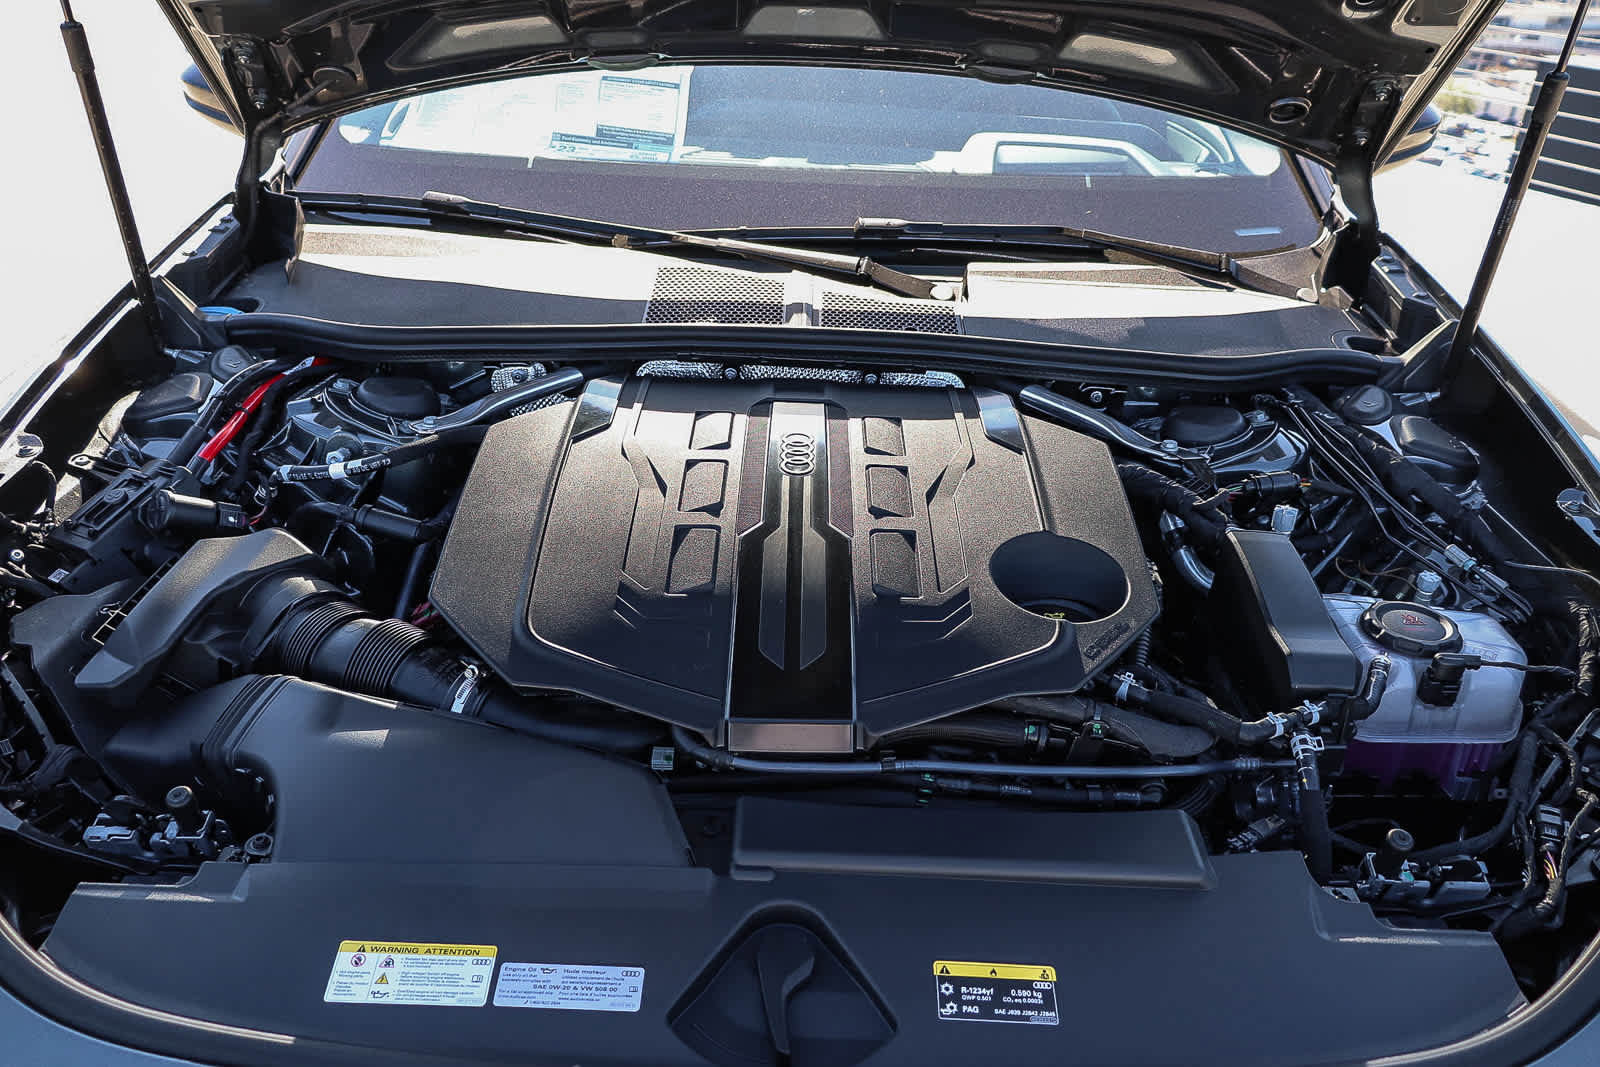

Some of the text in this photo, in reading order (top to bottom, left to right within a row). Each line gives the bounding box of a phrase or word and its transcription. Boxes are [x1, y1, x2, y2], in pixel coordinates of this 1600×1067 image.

[370, 945, 481, 956] WARNING ATTENTION
[960, 986, 994, 996] R-1234yf
[1032, 989, 1043, 999] kg
[962, 1005, 980, 1014] PAG
